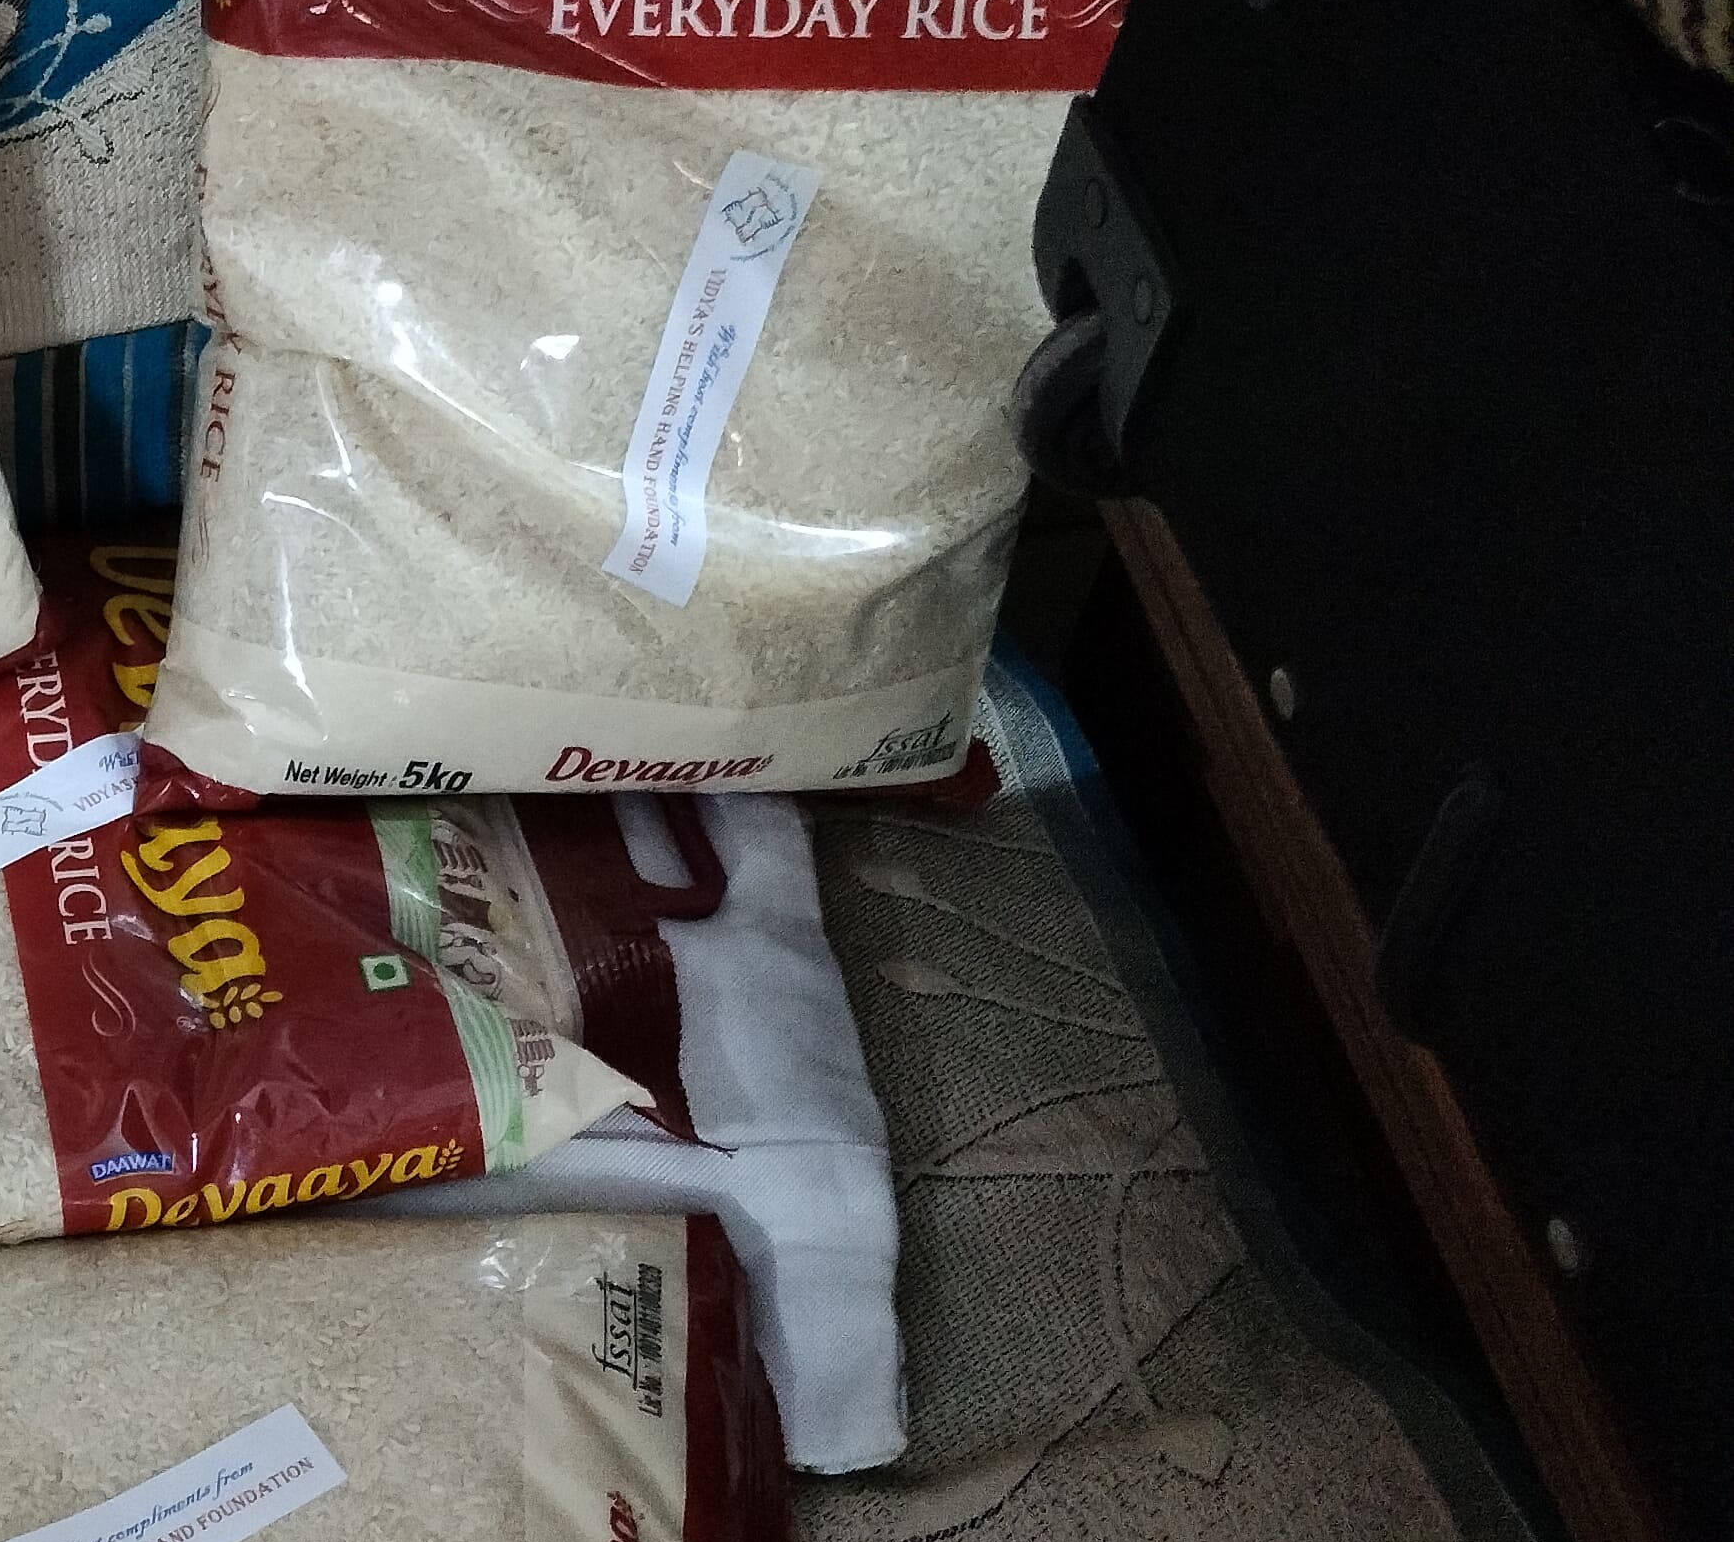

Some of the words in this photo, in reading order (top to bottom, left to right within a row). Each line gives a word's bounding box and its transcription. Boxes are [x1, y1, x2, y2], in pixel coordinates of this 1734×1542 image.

[662, 340, 697, 416] HELPING
[646, 417, 670, 469] HAND
[285, 760, 320, 787] Net
[322, 766, 387, 790] Weight
[398, 760, 472, 792] 5kg
[545, 746, 760, 785] Devaaya
[17, 651, 73, 773] ERYD
[49, 838, 112, 946] RICE
[93, 1154, 171, 1178] DAAWAT
[106, 1145, 440, 1231] Devaaya
[197, 1456, 315, 1531] FOUNDATION
[210, 1461, 254, 1500] from
